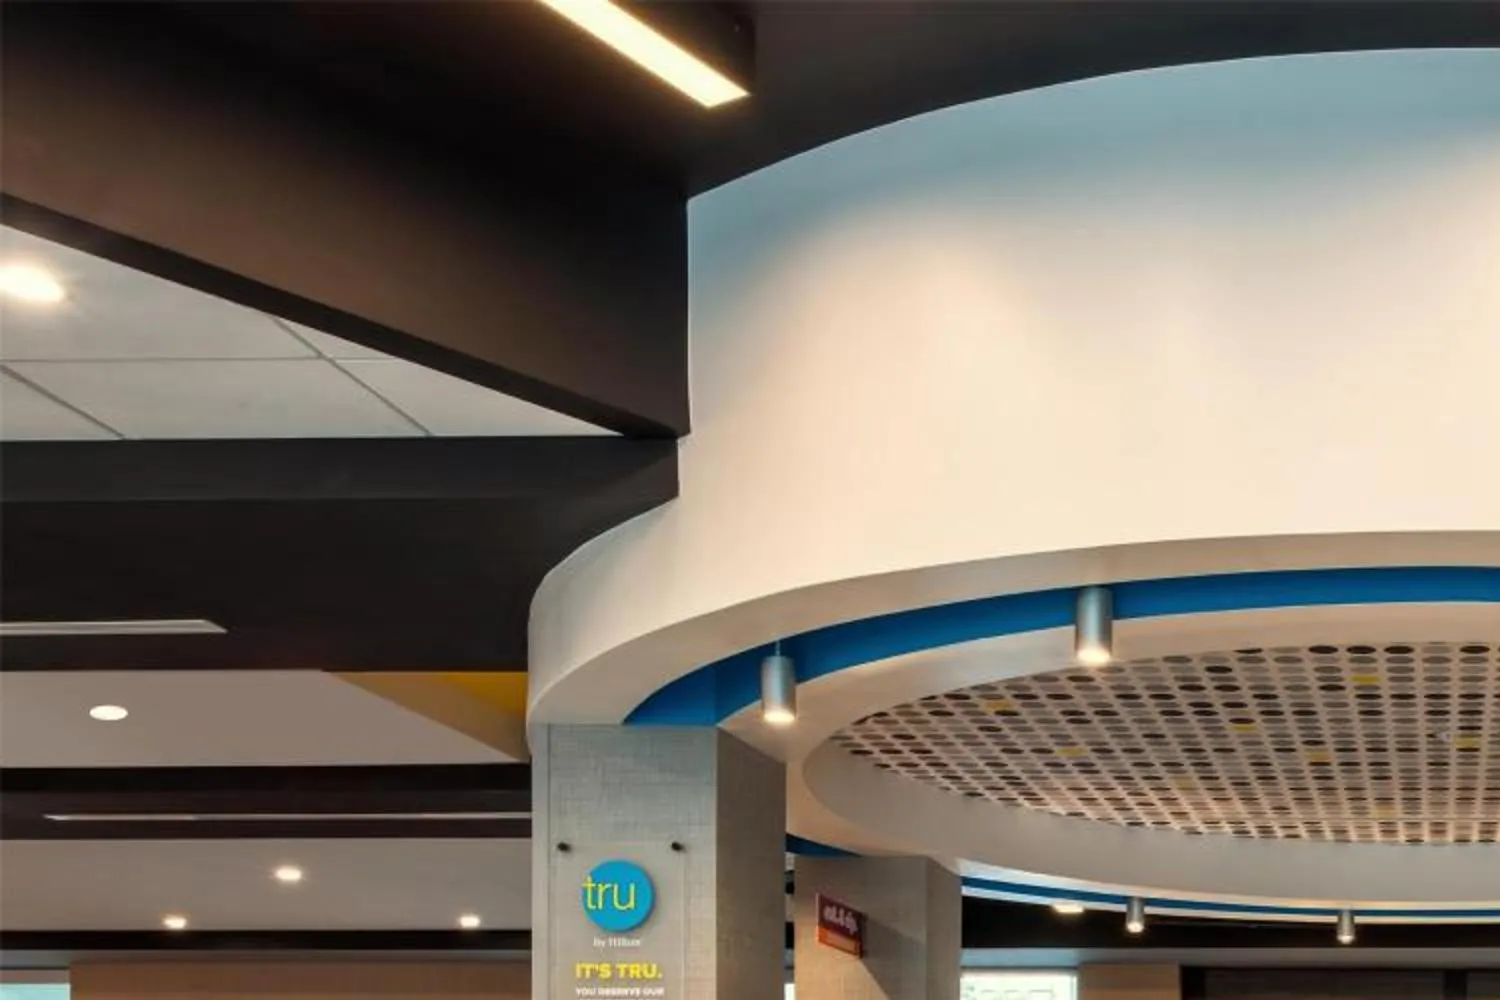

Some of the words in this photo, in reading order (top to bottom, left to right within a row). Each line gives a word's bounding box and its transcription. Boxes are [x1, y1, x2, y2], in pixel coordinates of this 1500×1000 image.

[582, 875, 636, 910] tru
[575, 962, 612, 979] IT'S
[615, 962, 663, 979] TRU.
[575, 987, 596, 996] YOU
[642, 987, 664, 996] OUR
